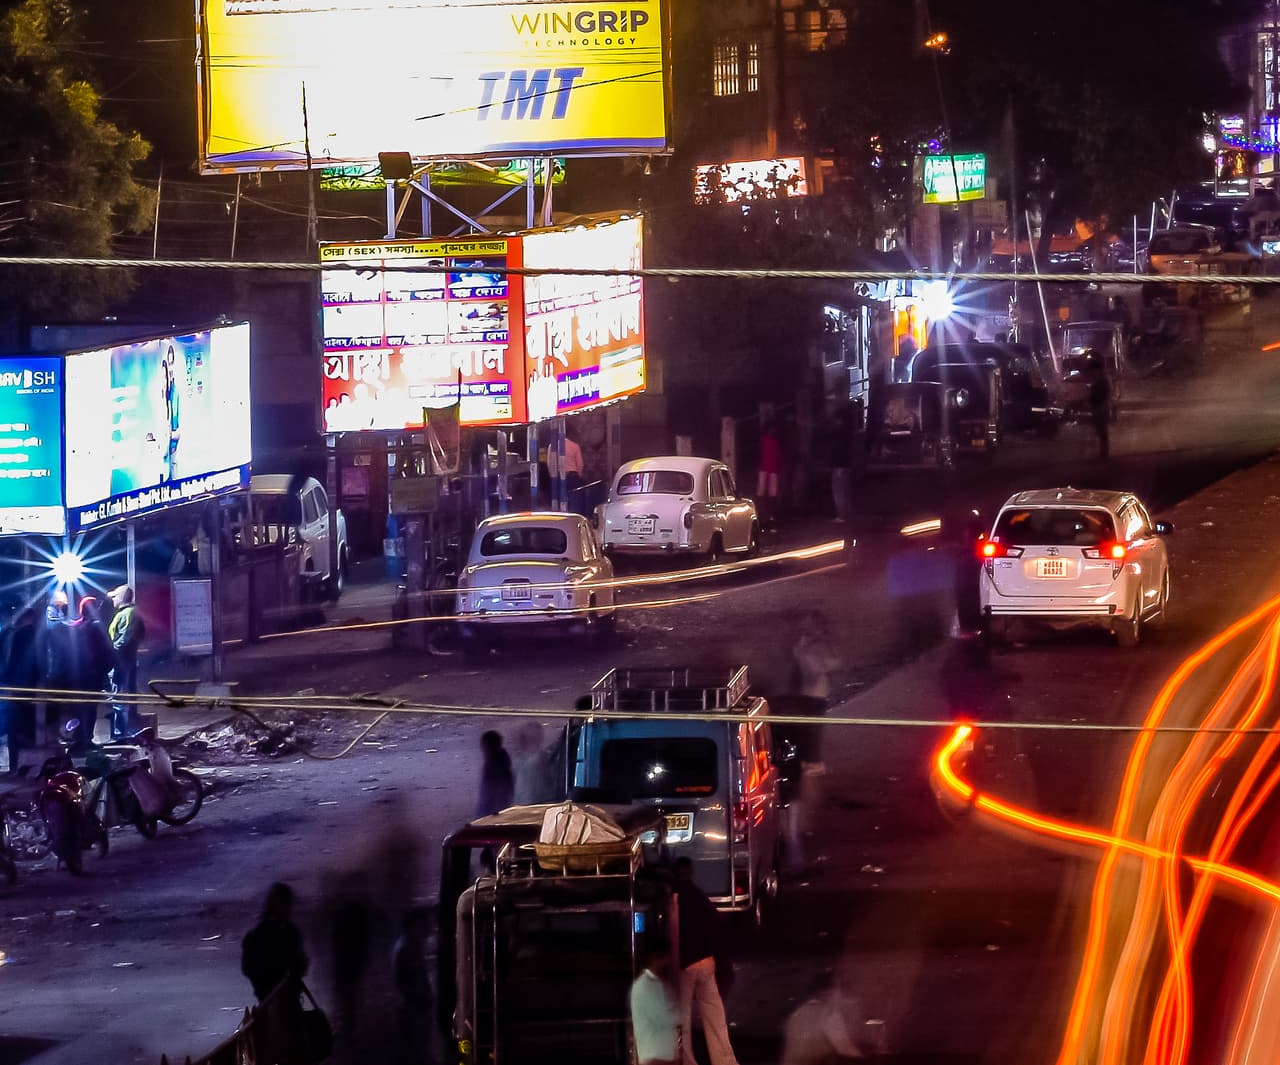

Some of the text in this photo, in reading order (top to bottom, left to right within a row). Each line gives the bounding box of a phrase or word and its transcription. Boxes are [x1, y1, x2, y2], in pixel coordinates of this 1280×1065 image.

[511, 10, 649, 35] WINGRIP
[477, 67, 585, 121] TMT
[348, 247, 382, 256] (SEX)
